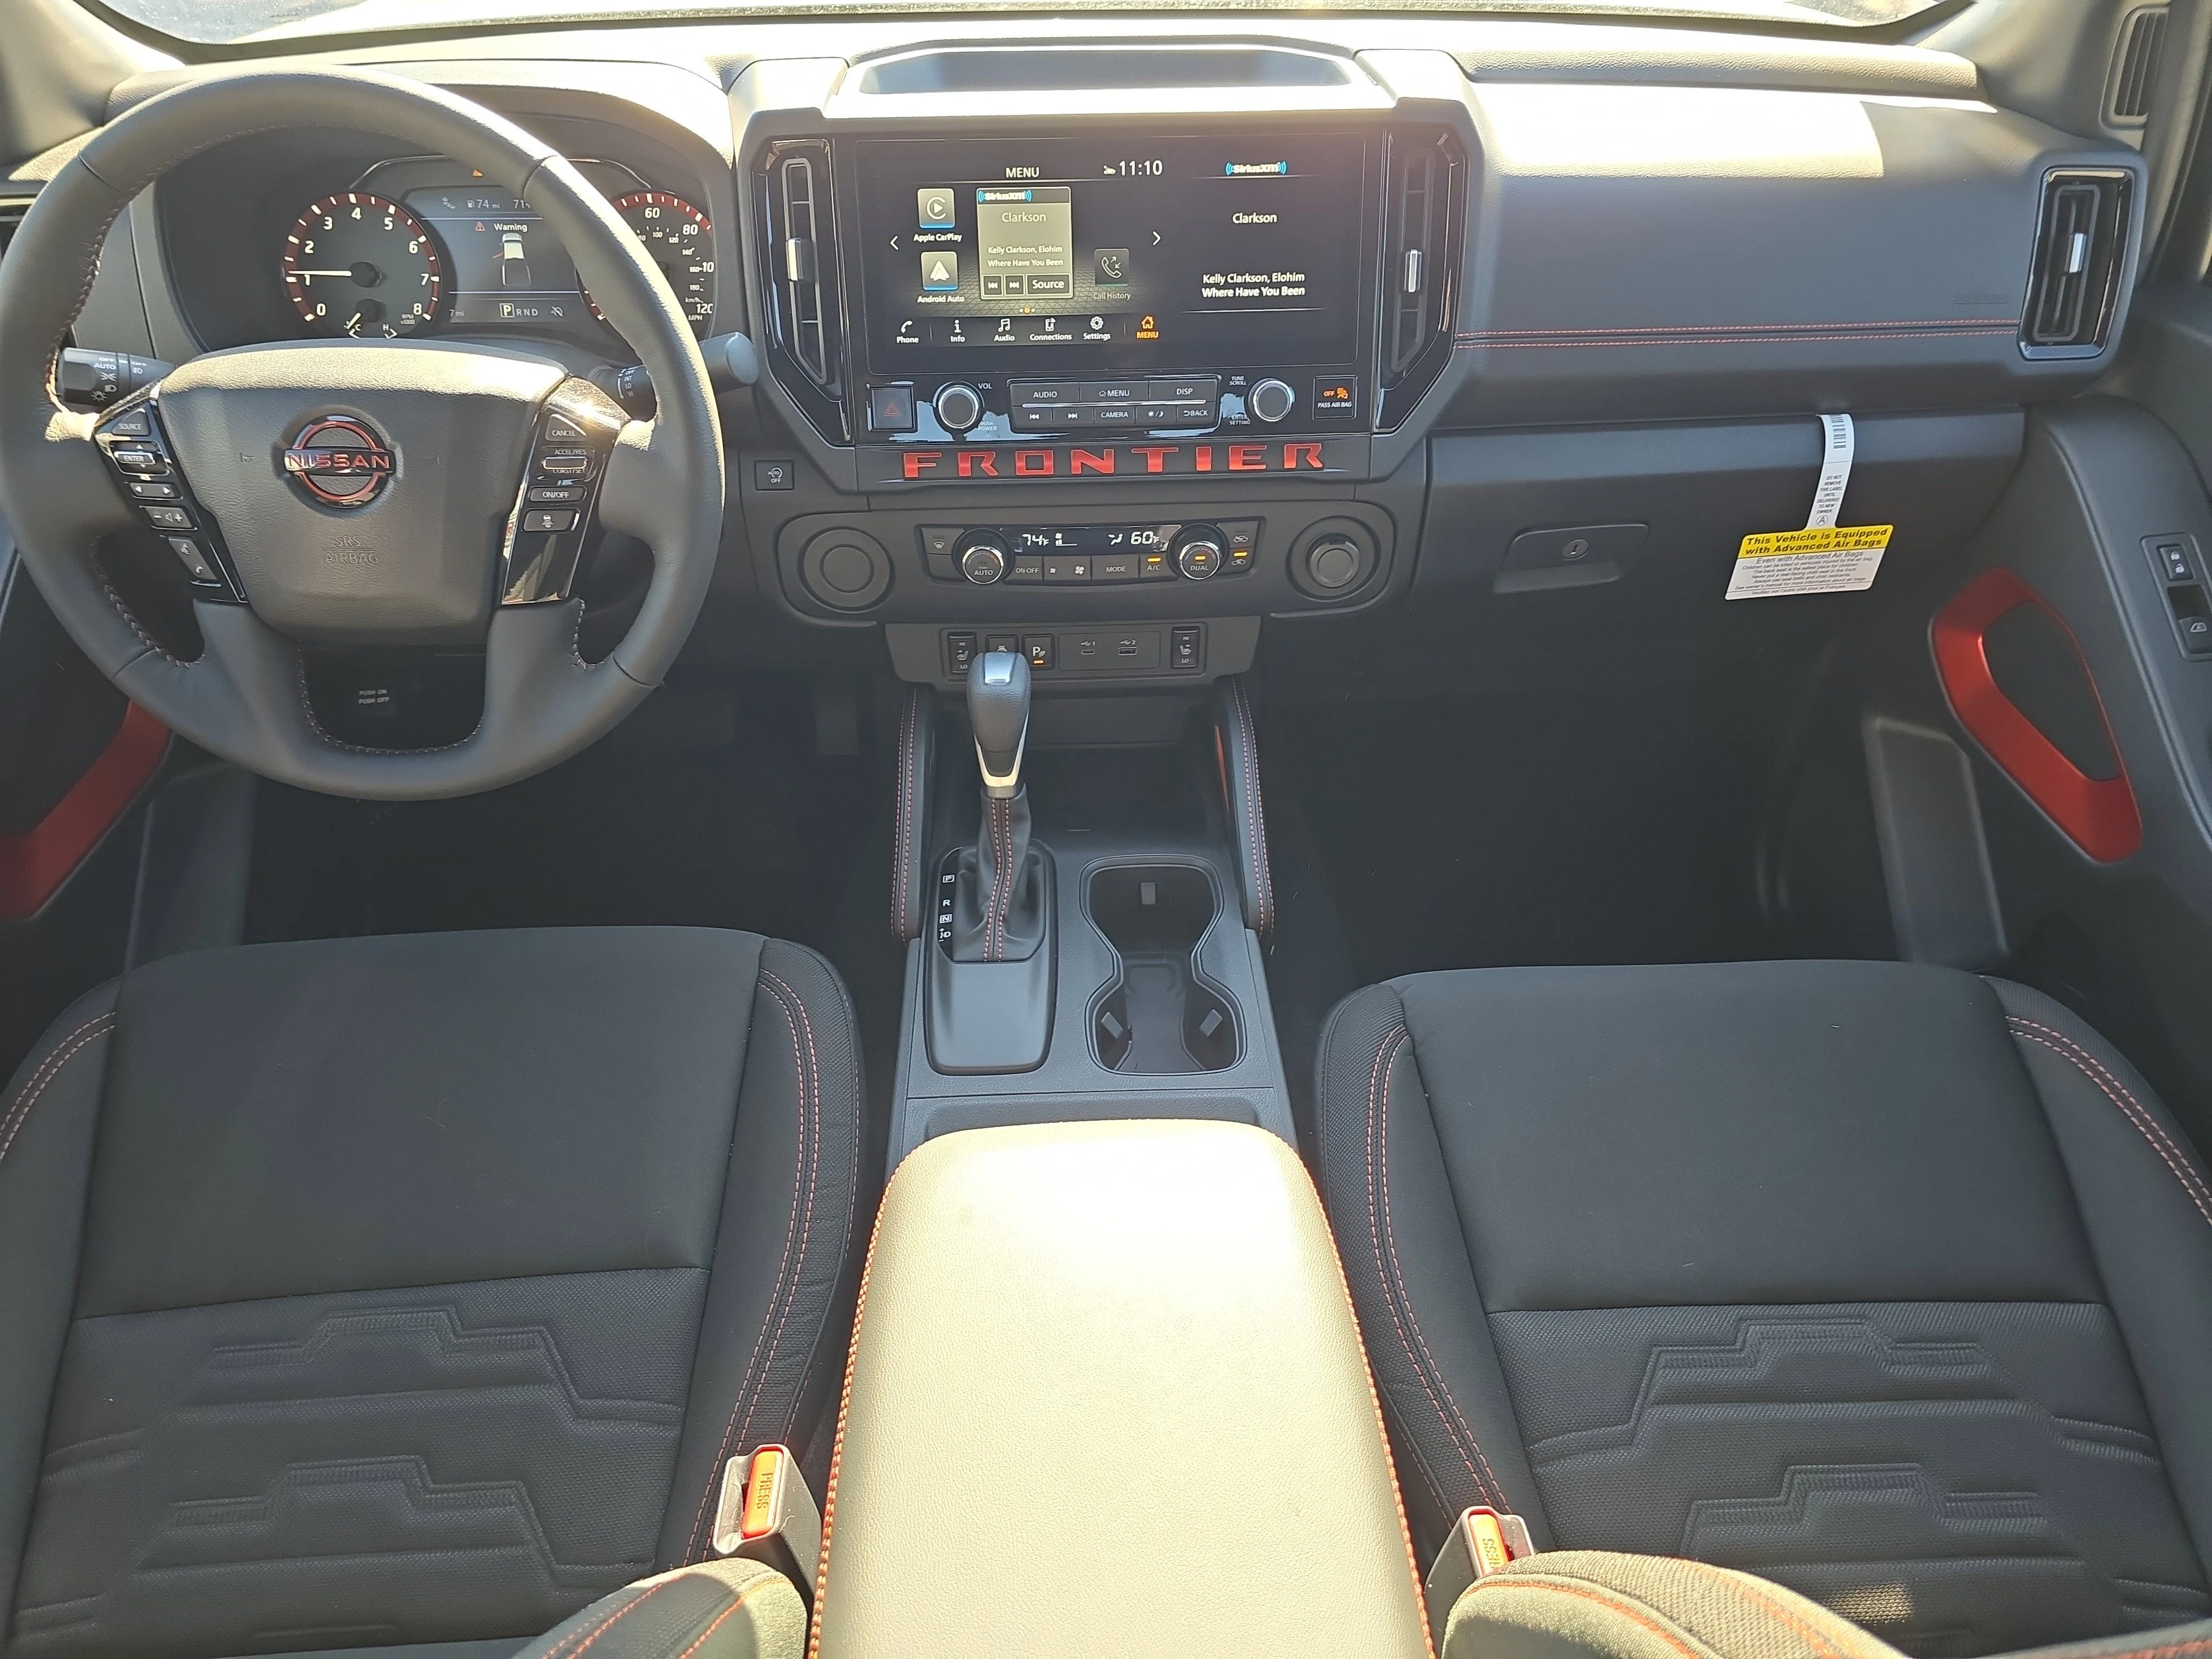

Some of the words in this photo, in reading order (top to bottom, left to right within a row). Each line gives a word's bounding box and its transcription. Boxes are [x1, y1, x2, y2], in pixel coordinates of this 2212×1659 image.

[1005, 167, 1040, 178] MENU
[1118, 160, 1163, 176] 11:10
[476, 199, 489, 209] 74
[351, 207, 362, 220] 4
[645, 207, 660, 218] 60
[1001, 211, 1046, 222] Clarkson
[1232, 212, 1277, 223] Clarkson
[323, 216, 333, 230] 3
[384, 217, 393, 230] 5
[493, 222, 528, 233] Warning
[683, 224, 698, 235] 80
[914, 234, 935, 242] Apple
[936, 233, 962, 242] CarPlay
[304, 240, 314, 254] 2
[409, 241, 418, 254] 6
[988, 246, 1005, 255] Kelly
[1006, 246, 1038, 254] Clarkson,
[1038, 245, 1063, 253] Elohim
[304, 273, 310, 286] 1
[421, 273, 429, 286] 7
[1203, 273, 1226, 285] Kelly
[1227, 272, 1270, 284] Clarkson,
[1272, 272, 1305, 282] Elohim
[1032, 279, 1065, 290] Source
[1107, 292, 1131, 301] History
[1201, 287, 1234, 298] Where
[1236, 287, 1259, 297] Have
[1262, 286, 1279, 297] You
[1281, 286, 1306, 296] Been
[917, 295, 946, 303] Android
[316, 303, 326, 316] 0
[413, 303, 422, 315] 8
[896, 336, 919, 344] Phone
[950, 335, 966, 343] Info
[993, 334, 1015, 342] Audio
[1030, 333, 1073, 341] Connections
[1083, 332, 1111, 341] Settings
[1136, 331, 1159, 339] MENU
[1033, 390, 1058, 399] AUDIO
[1107, 388, 1130, 397] MENU
[1176, 388, 1193, 396] DISP
[1101, 410, 1129, 419] CAMERA
[1190, 408, 1208, 417] BACK
[287, 453, 390, 470] NISSAN
[902, 442, 1323, 478] FRONTIER
[334, 536, 360, 547] SRS
[1747, 537, 1771, 545] This
[1776, 533, 1817, 543] Vehicle
[1834, 528, 1888, 540] Equipped
[1745, 546, 1770, 555] with
[1773, 541, 1831, 552] Advanced
[1832, 540, 1851, 549] Air
[1853, 539, 1882, 548] Bags
[324, 552, 380, 564] AIRBAG
[1793, 552, 1831, 561] Advanced
[1032, 646, 1041, 657] P
[756, 1472, 773, 1510] PRESS
